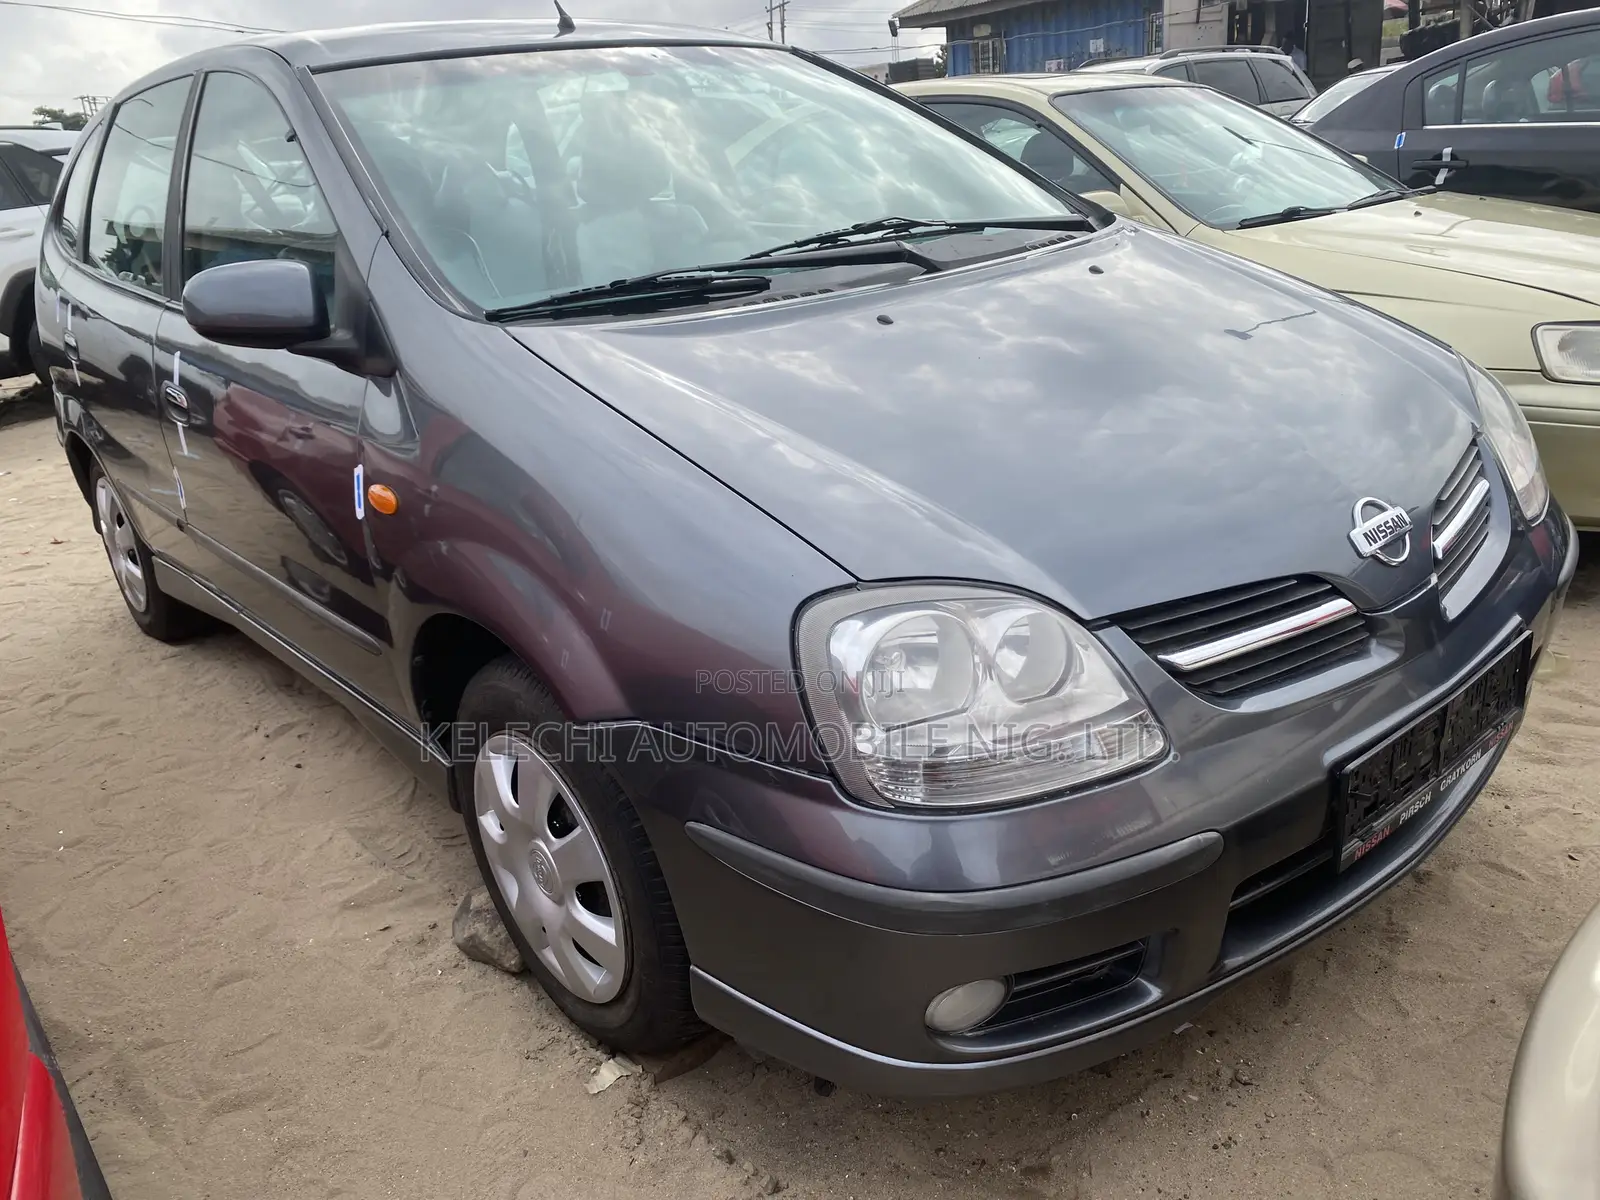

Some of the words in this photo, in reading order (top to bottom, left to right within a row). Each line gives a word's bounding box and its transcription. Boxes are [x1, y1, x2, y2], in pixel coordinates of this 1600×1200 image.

[1362, 512, 1409, 547] NISSAN
[1354, 825, 1391, 861] NISSAN
[1399, 791, 1432, 825] PIRSCH
